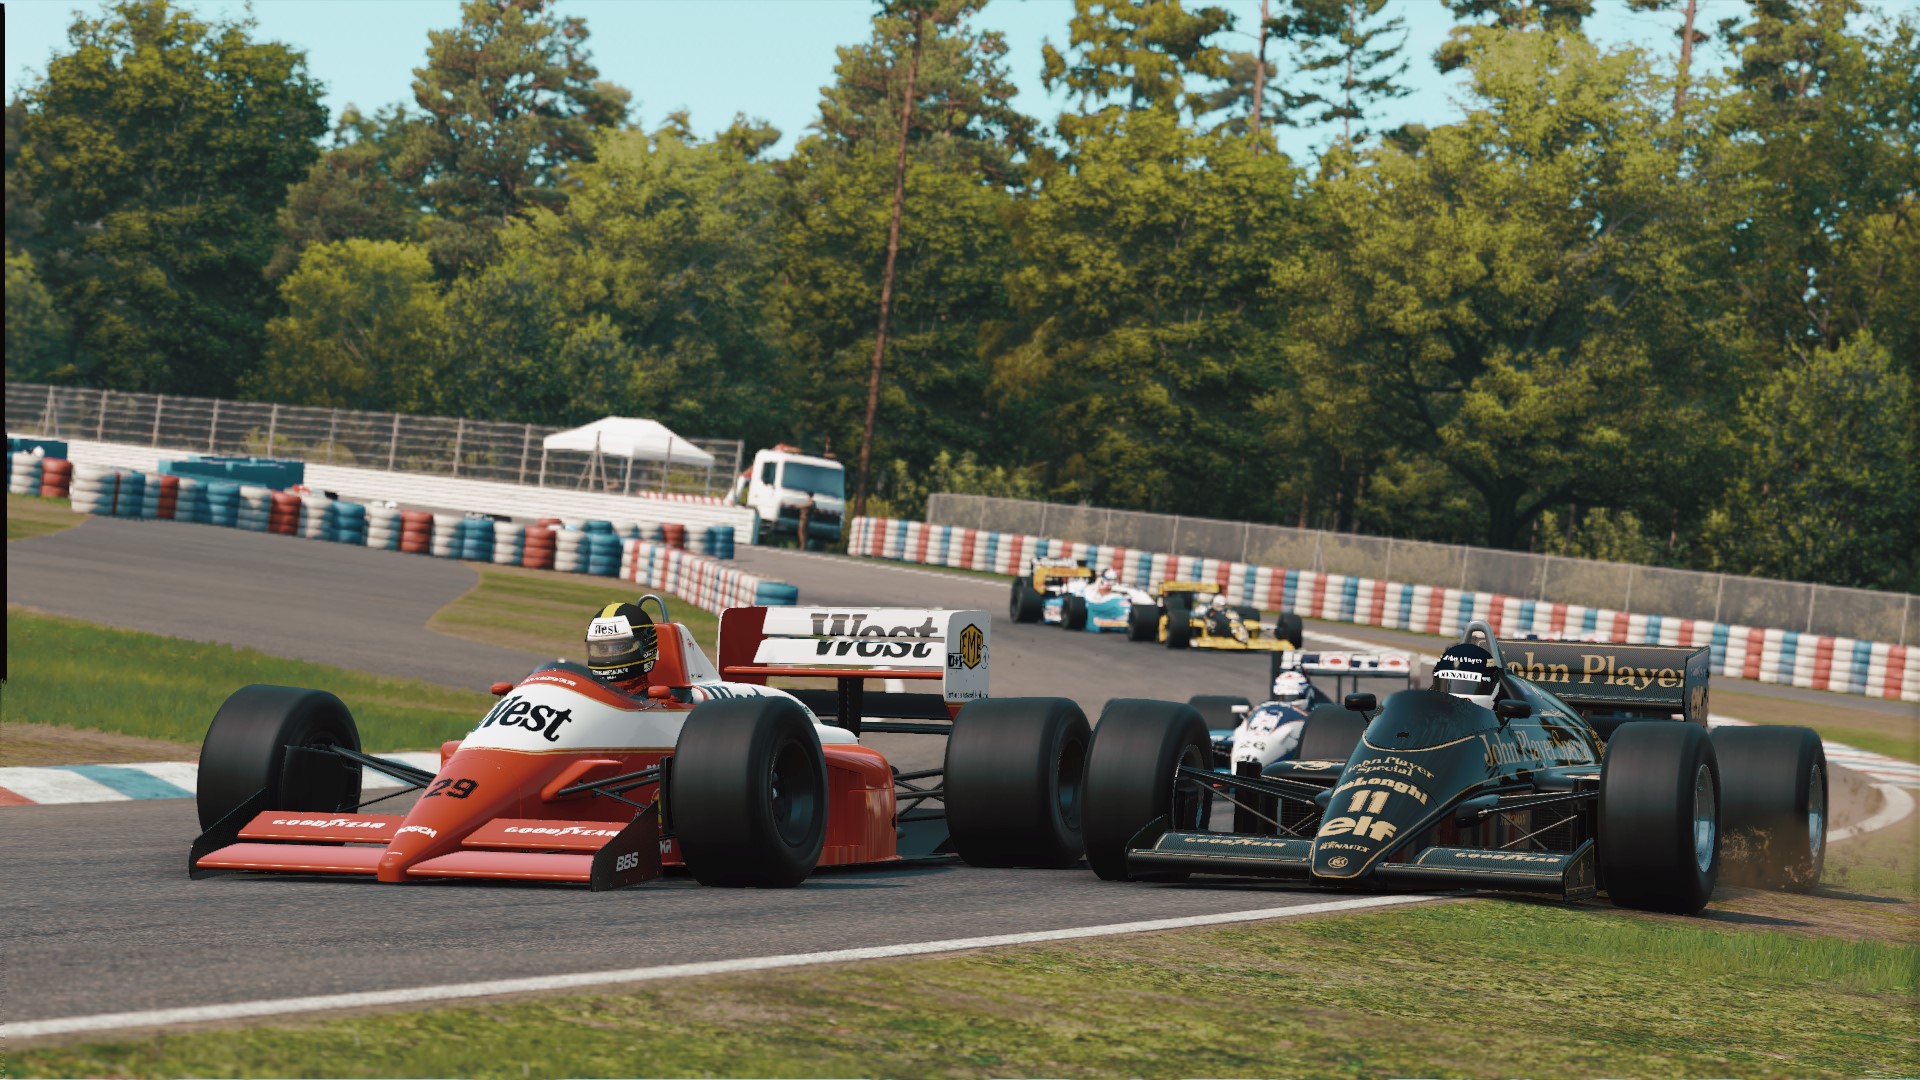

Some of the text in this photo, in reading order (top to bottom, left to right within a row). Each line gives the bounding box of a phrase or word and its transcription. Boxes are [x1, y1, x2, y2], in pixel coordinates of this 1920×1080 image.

[810, 613, 938, 658] West
[1503, 652, 1570, 683] ohn
[1479, 732, 1519, 767] John
[1514, 729, 1556, 768] Player
[1384, 756, 1435, 778] Player
[424, 778, 478, 799] 29
[1347, 789, 1390, 814] 11
[272, 818, 387, 828] GOODYEAR
[1318, 815, 1398, 841] elf
[616, 852, 638, 871] BBS
